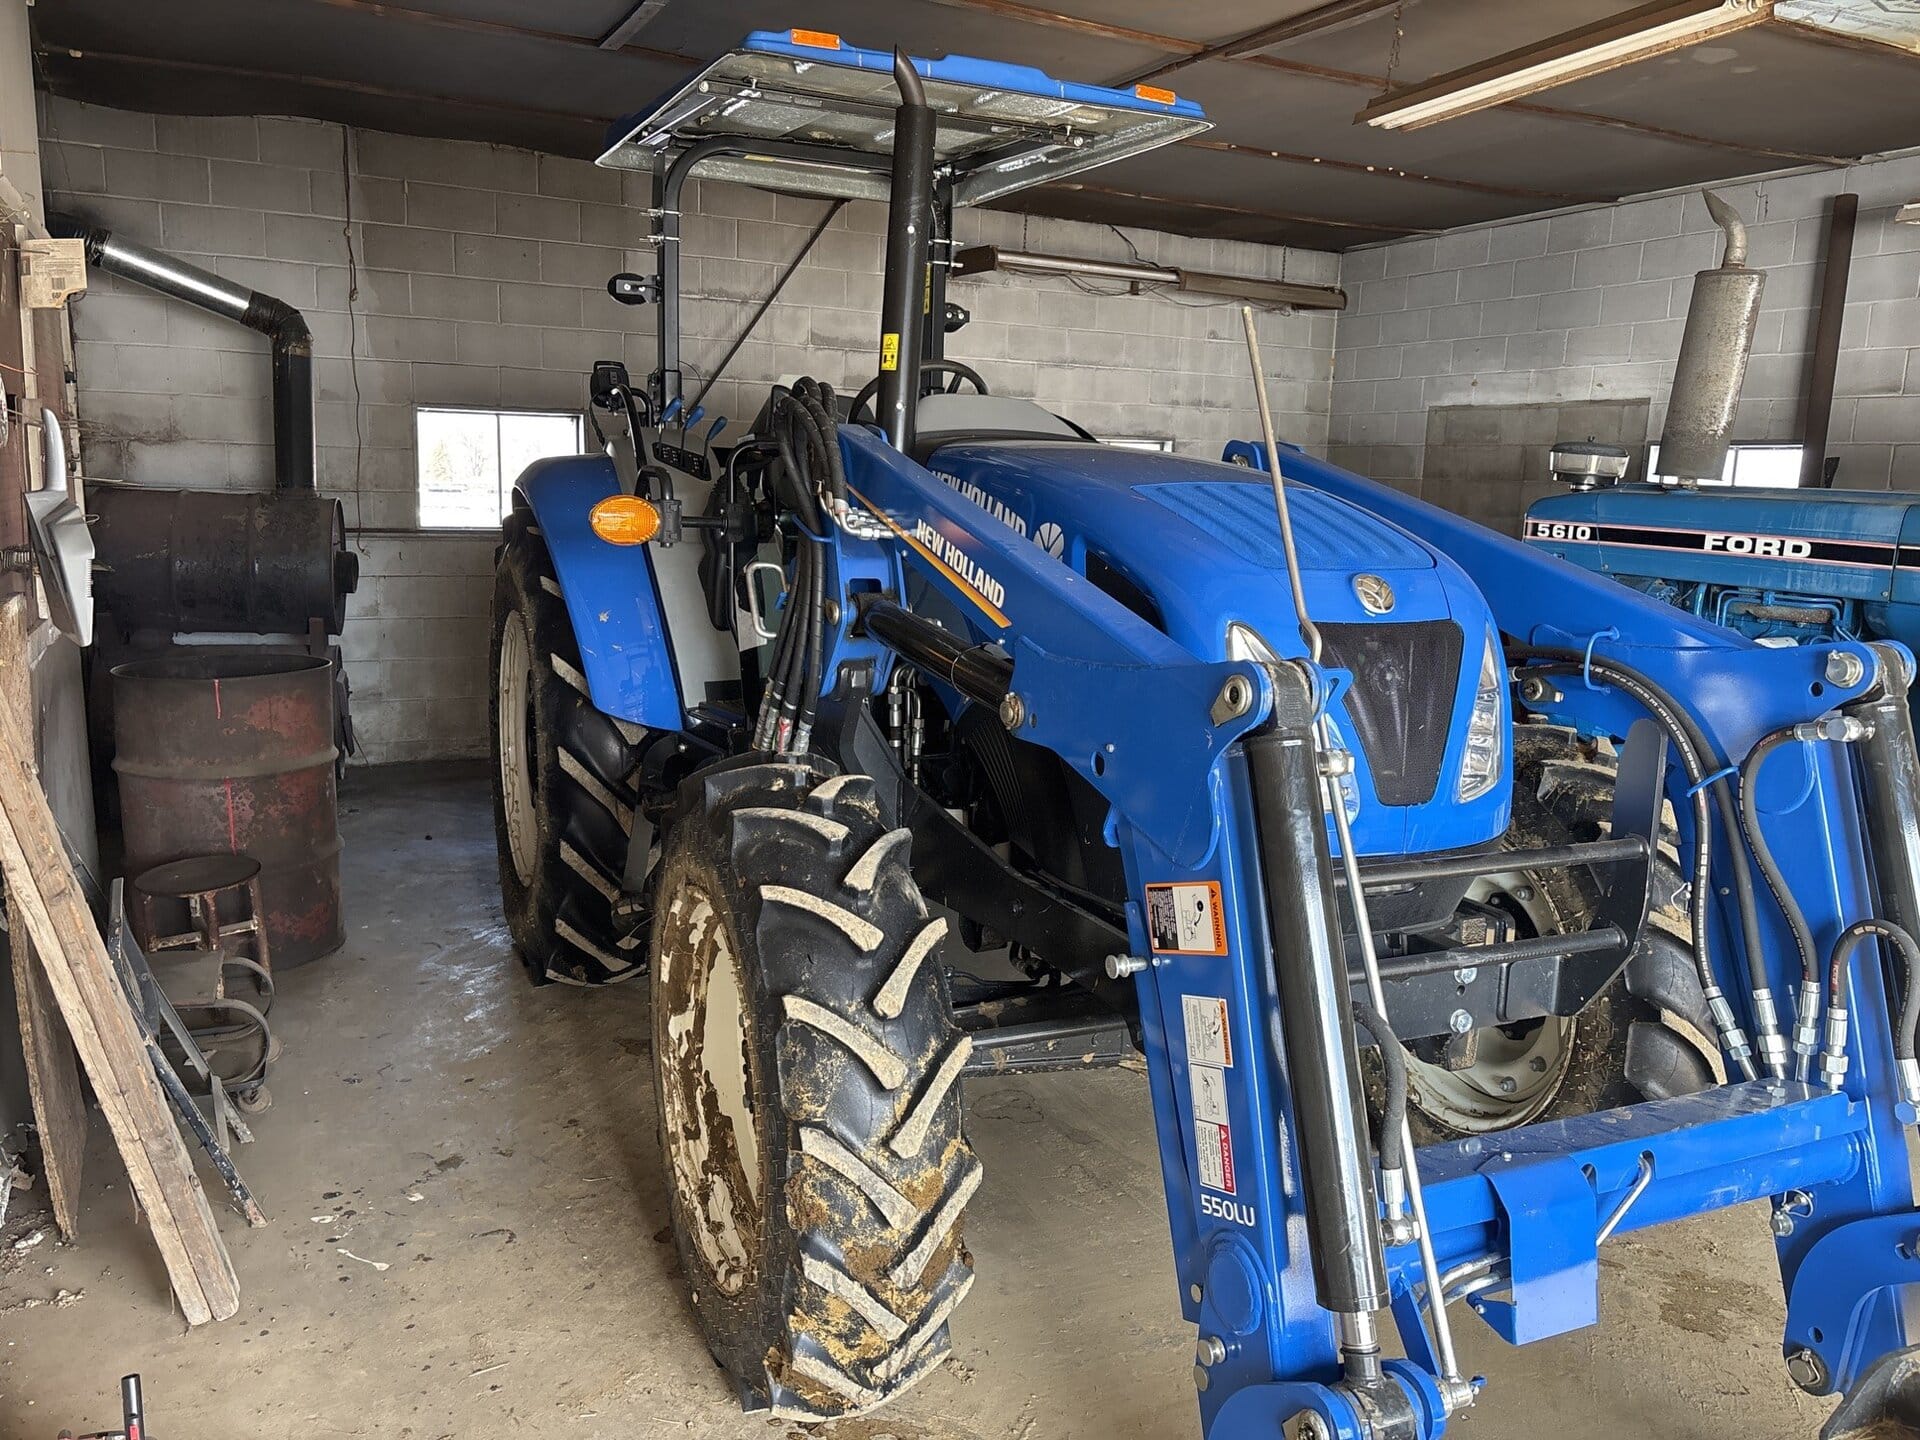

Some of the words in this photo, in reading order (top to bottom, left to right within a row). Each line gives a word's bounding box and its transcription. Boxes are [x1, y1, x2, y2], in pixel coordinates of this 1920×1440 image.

[961, 481, 1026, 538] HOLLAND
[1537, 523, 1591, 540] 5610
[1704, 534, 1812, 558] FORD
[916, 518, 945, 557] NEW
[944, 540, 1005, 609] HOLLAND
[1212, 901, 1223, 948] WARNING
[1222, 1018, 1231, 1060] WARNING
[1222, 1143, 1233, 1188] DANGER
[1201, 1193, 1256, 1227] 550LU
